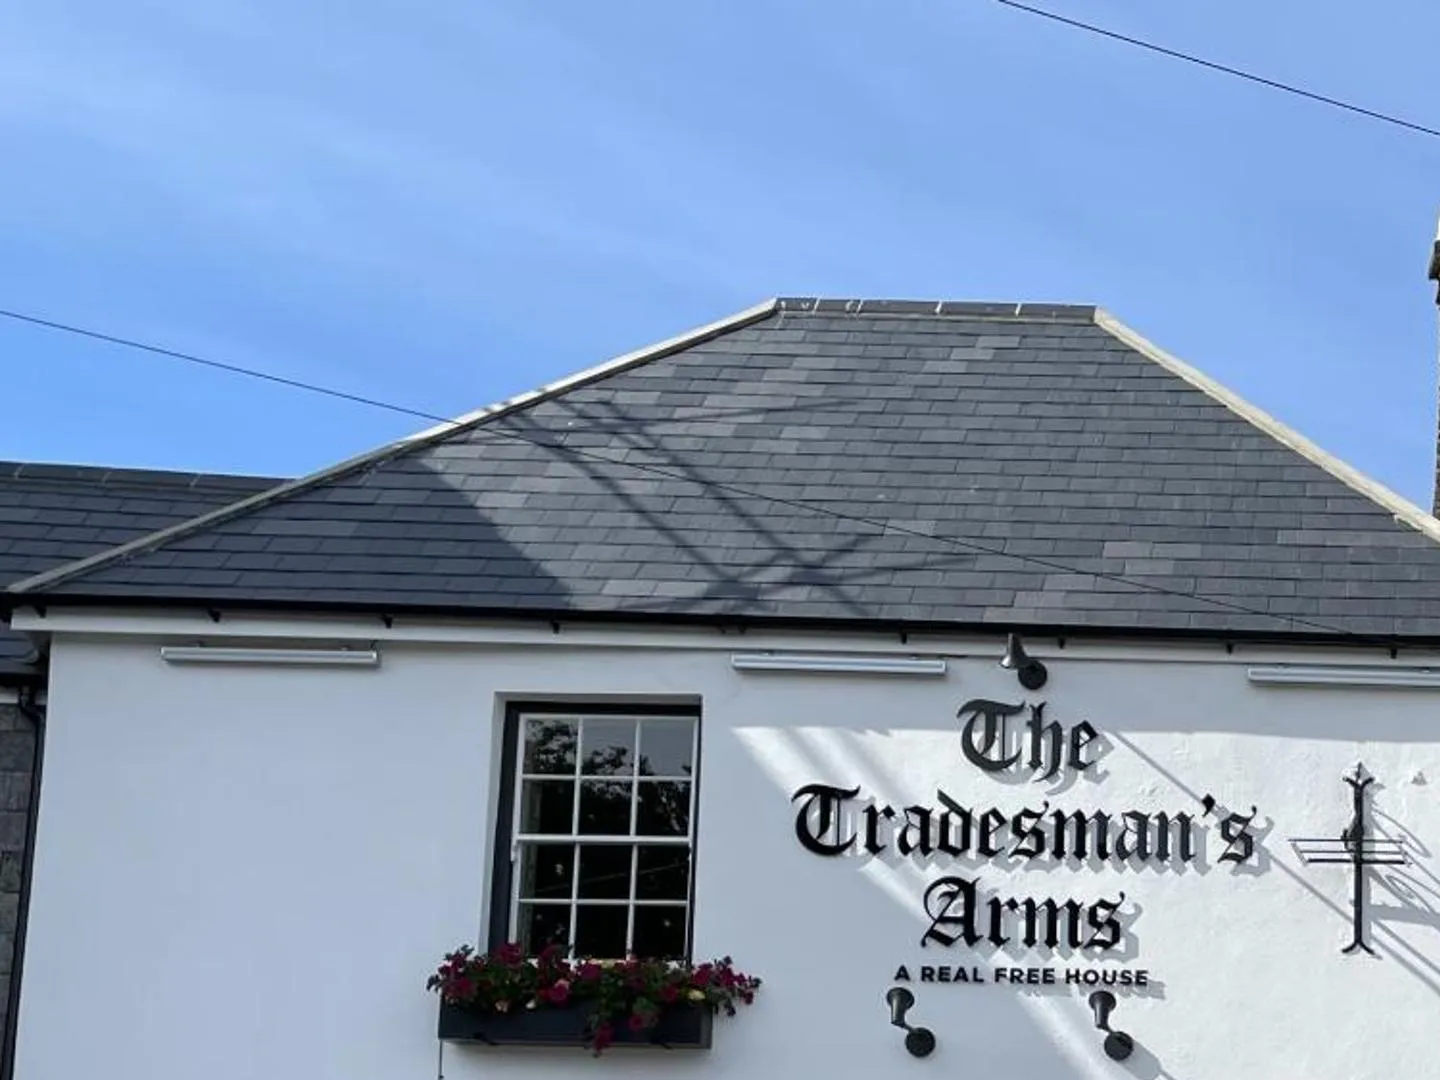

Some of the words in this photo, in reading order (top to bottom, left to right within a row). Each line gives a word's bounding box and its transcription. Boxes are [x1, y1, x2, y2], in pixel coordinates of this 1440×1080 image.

[957, 699, 1099, 782] The
[791, 783, 1256, 865] Tradesman's
[920, 876, 1125, 951] Arms
[893, 965, 911, 982] A
[920, 965, 985, 984] REAL
[994, 967, 1056, 986] FREE
[1065, 969, 1148, 987] HOUSE
